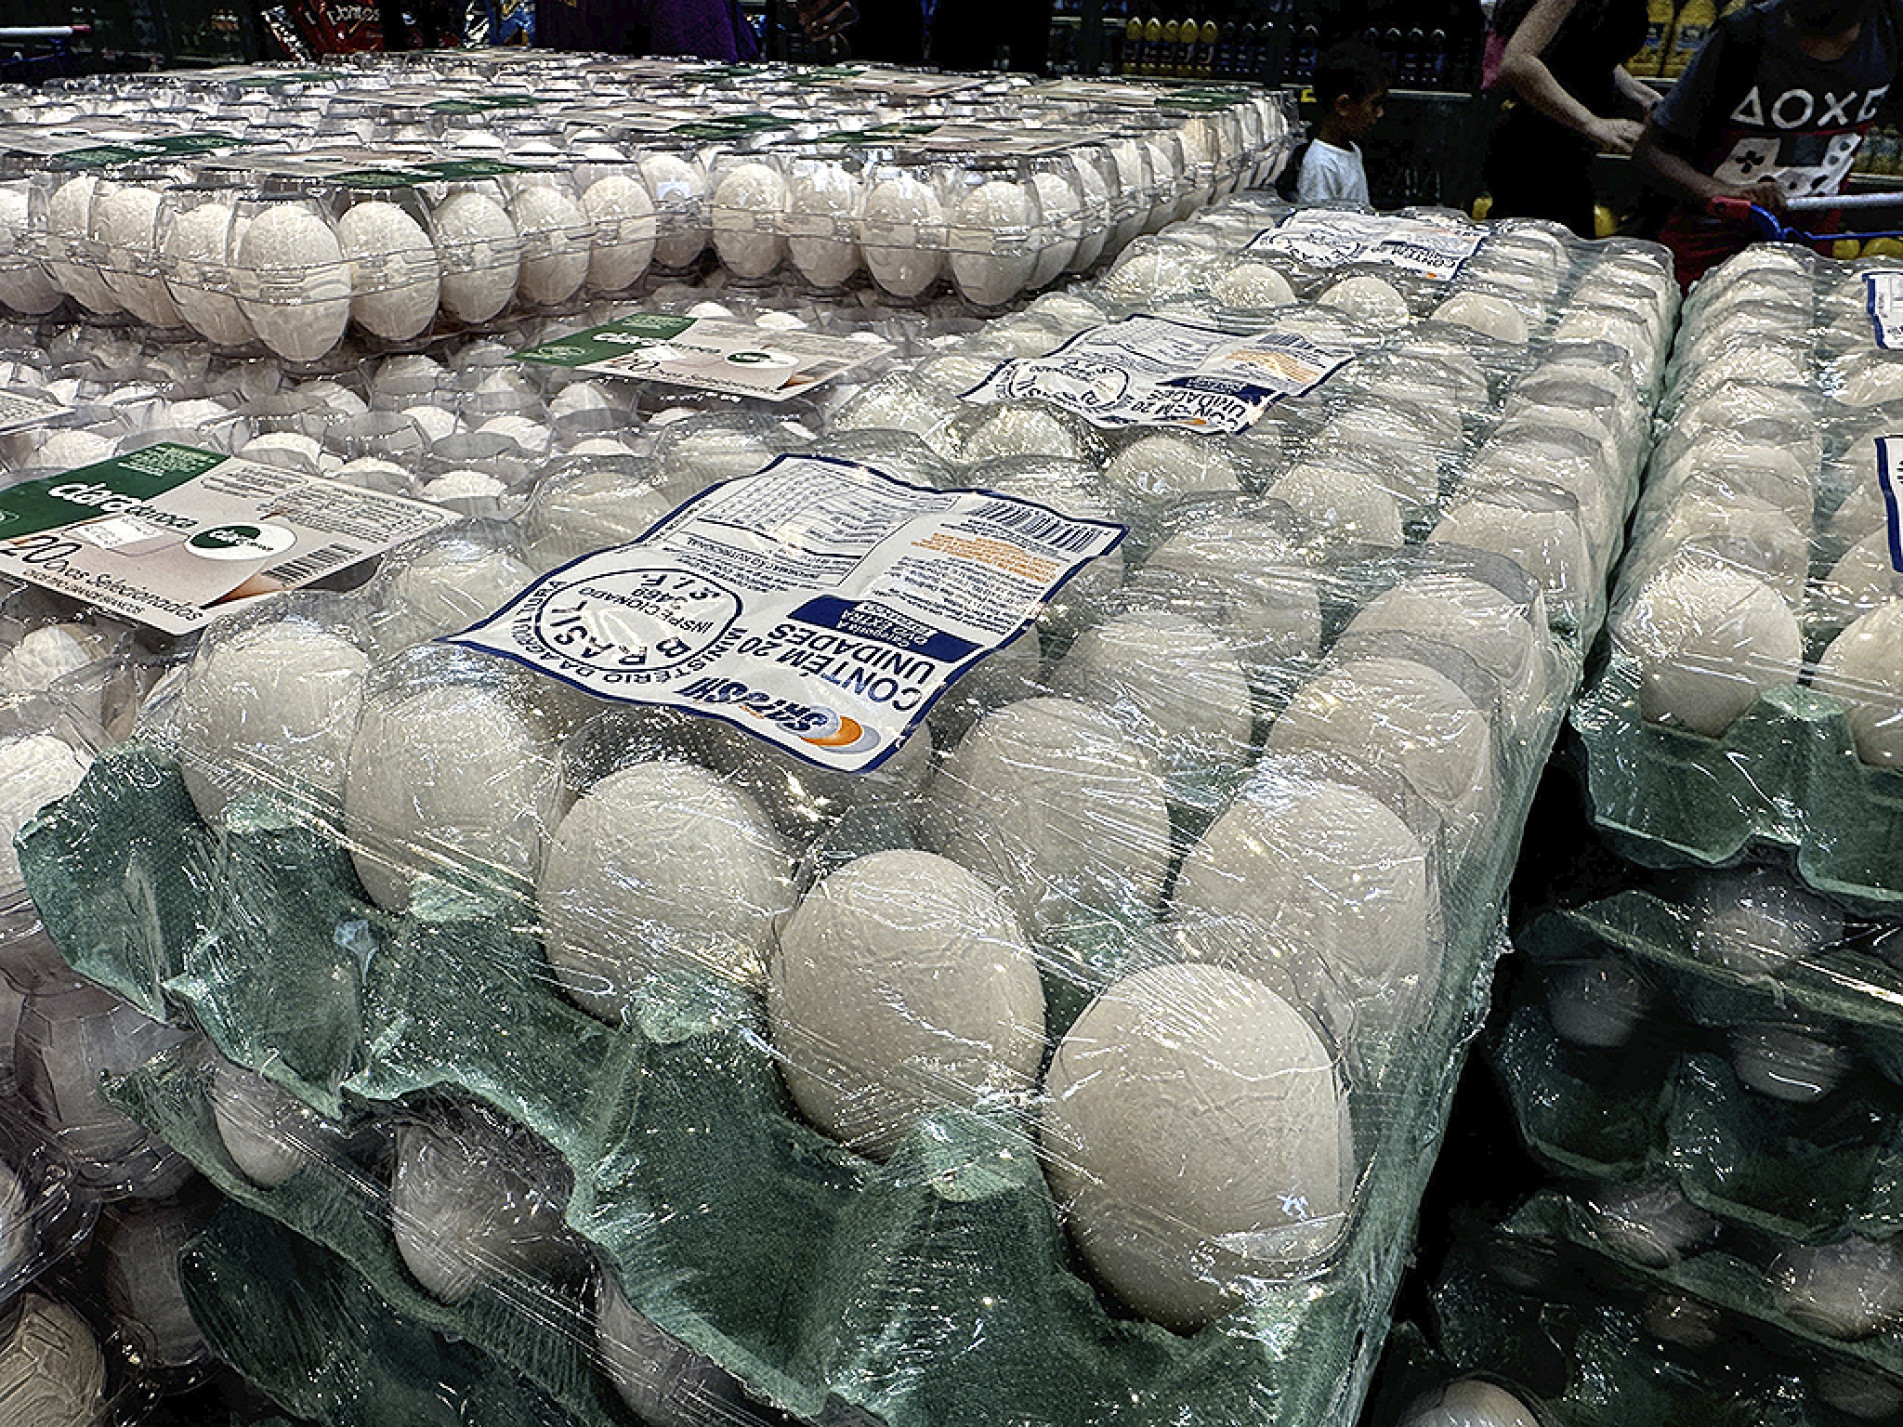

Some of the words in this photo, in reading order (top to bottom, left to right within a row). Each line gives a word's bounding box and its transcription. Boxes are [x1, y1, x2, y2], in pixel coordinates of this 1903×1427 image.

[549, 600, 692, 666] BRASIL
[577, 586, 715, 634] INSPECIONADO
[737, 636, 780, 657] 20
[767, 623, 936, 685] UNIDADES
[775, 648, 922, 712] CONTÉM
